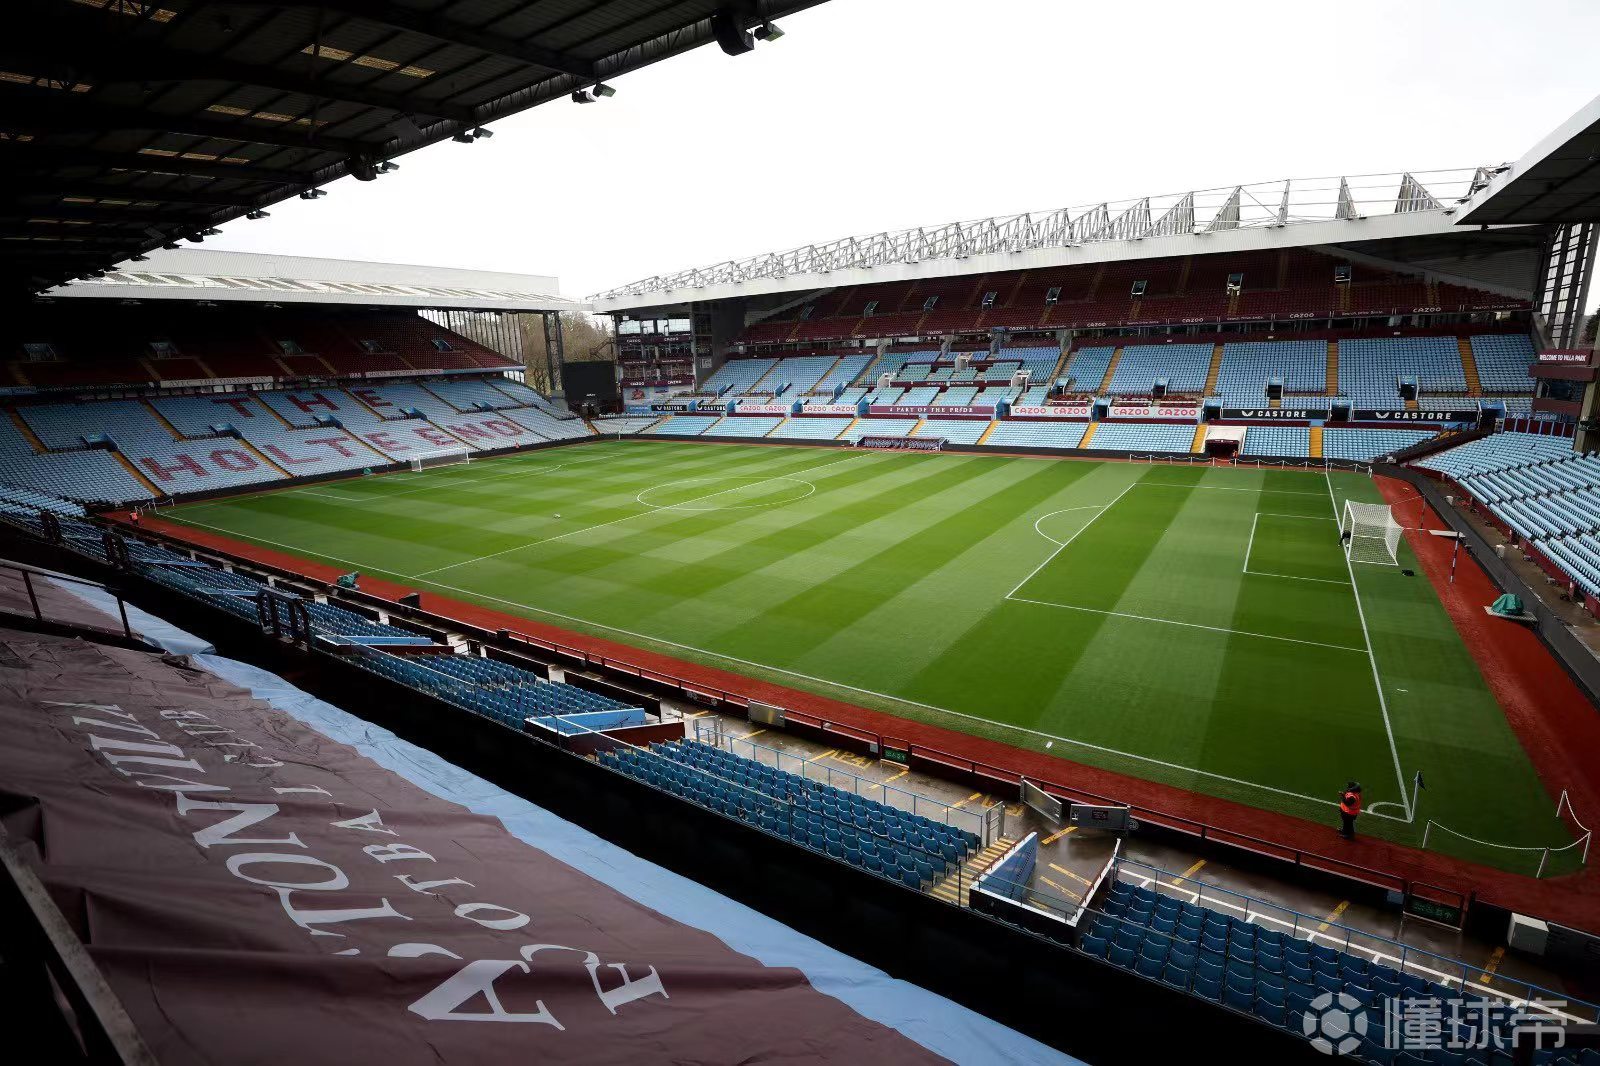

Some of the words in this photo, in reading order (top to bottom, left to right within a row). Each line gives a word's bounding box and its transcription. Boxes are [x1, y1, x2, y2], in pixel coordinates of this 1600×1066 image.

[210, 388, 392, 418] THE
[1053, 407, 1088, 415] CAZOO
[1157, 408, 1197, 416] CAZOO
[1257, 410, 1307, 418] CASTORE
[1394, 411, 1452, 420] CASTORE
[139, 431, 412, 481] HOLTE
[416, 418, 523, 446] END
